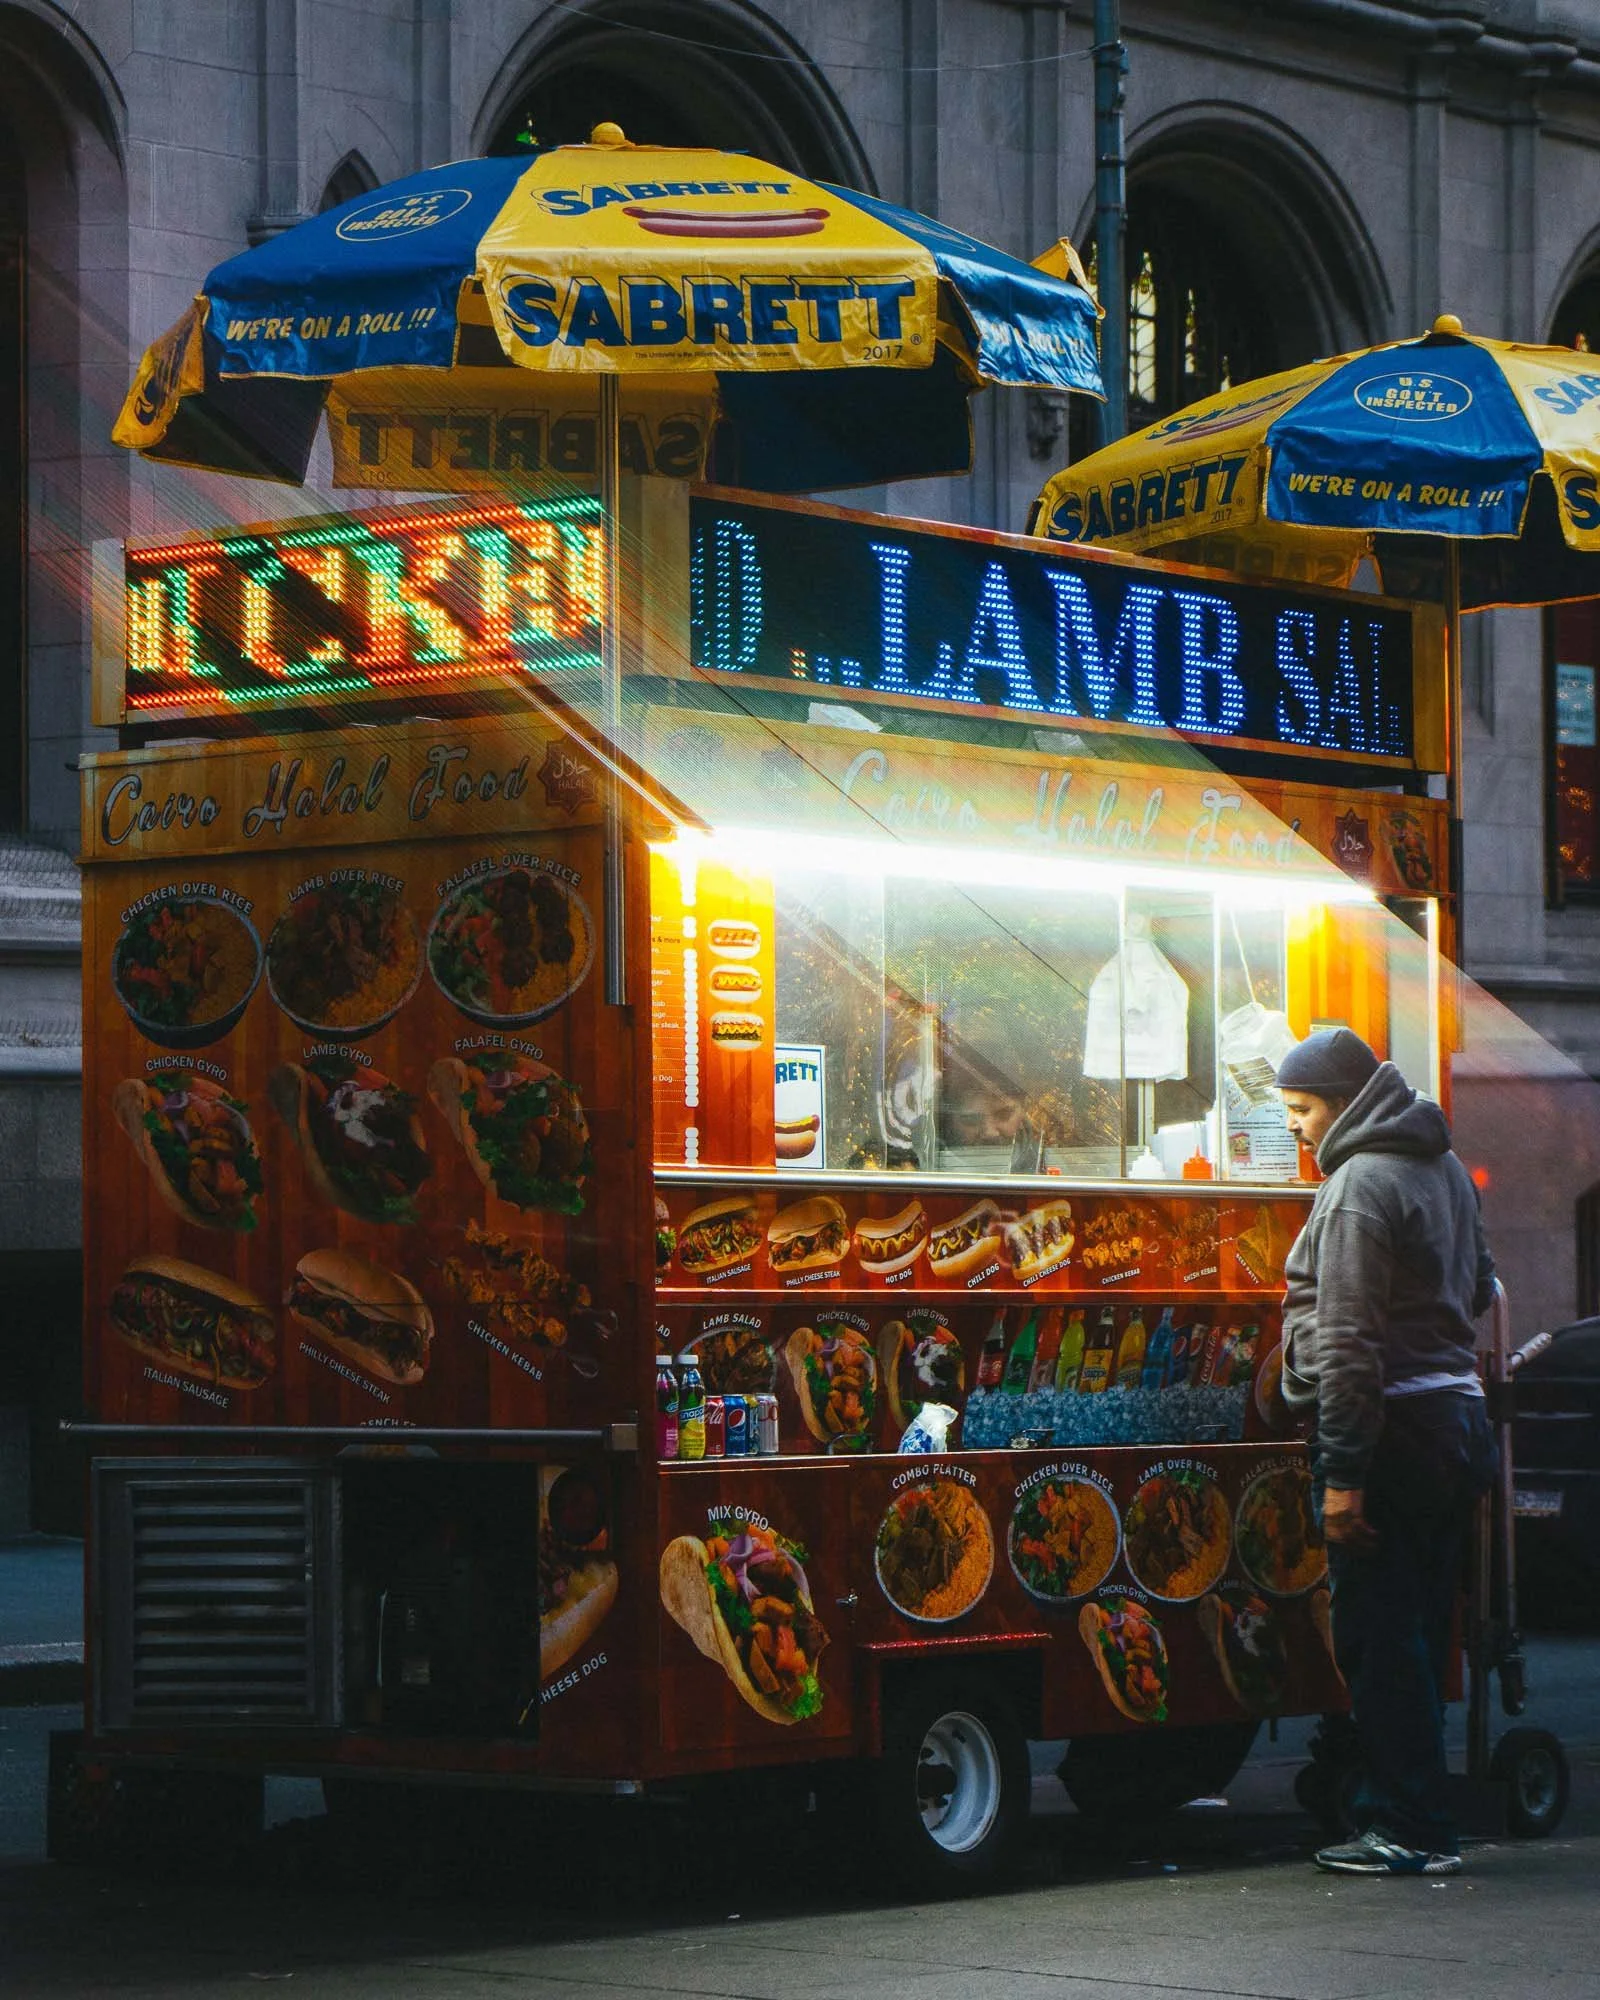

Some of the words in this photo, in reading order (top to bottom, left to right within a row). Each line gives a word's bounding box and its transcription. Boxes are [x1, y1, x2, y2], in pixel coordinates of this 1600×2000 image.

[532, 179, 797, 216] SABRETT
[344, 215, 440, 231] INSPECTED
[500, 274, 915, 348] SABRETT
[225, 317, 294, 341] WE'RE
[300, 315, 333, 339] ON
[336, 316, 353, 337] A
[355, 313, 403, 336] ROLL
[864, 345, 904, 360] 2017
[1366, 397, 1457, 413] INSPECTED
[1048, 449, 1249, 542] SABRETT
[1288, 473, 1356, 497] WE'RE
[1361, 480, 1393, 501] ON
[1397, 484, 1412, 502] A
[1418, 485, 1471, 507] ROLL
[101, 773, 221, 846] Cairo
[243, 752, 390, 838] Halal
[408, 744, 531, 821] Food
[288, 874, 326, 902] LAMB
[329, 869, 366, 885] OVER
[370, 871, 404, 893] RICE
[436, 857, 497, 897] FALAFEL
[501, 854, 541, 869] OVER
[544, 859, 582, 887] RICE
[120, 883, 177, 924] CHICKEN
[183, 882, 216, 896] OVER
[222, 888, 254, 914] RICE
[303, 1043, 337, 1059] LAMB
[339, 1046, 373, 1067] GYRO
[454, 1035, 507, 1053] FALAFEL
[510, 1038, 544, 1060] GYRO
[145, 1055, 194, 1072] CHICKEN
[196, 1060, 228, 1081] GYRO
[706, 1272, 727, 1285] ITALIAN
[727, 1263, 752, 1277] SAUSAGE
[804, 1273, 825, 1284] CHEESE
[825, 1270, 841, 1280] STEAK
[885, 1275, 899, 1285] HOT
[899, 1268, 913, 1280] DOG
[967, 1270, 985, 1288] CHILI
[984, 1262, 1000, 1278] DOG
[1022, 1273, 1039, 1287] CHILI
[1059, 1257, 1071, 1270] DOG
[703, 1314, 730, 1330] LAMB
[731, 1312, 762, 1329] SALAD
[816, 1311, 851, 1322] CHICKEN
[850, 1313, 871, 1332] GYRO
[906, 1308, 929, 1319] LAMB
[928, 1308, 949, 1326] GYRO
[467, 1319, 511, 1356] CHICKEN
[511, 1351, 544, 1381] KEBAB
[299, 1341, 329, 1364] PHILLY
[328, 1358, 363, 1385] CHEESE
[362, 1379, 391, 1404] STEAK
[143, 1367, 181, 1388] ITALIAN
[182, 1380, 230, 1408] SAUSAGE
[892, 1464, 930, 1490] COMBO
[932, 1463, 978, 1487] PLATTER
[1014, 1463, 1059, 1499] CHICKEN
[1061, 1462, 1088, 1475] OVER
[1090, 1470, 1114, 1494] RICE
[1138, 1463, 1165, 1484] LAMB
[1167, 1459, 1193, 1471] OVER
[1196, 1462, 1219, 1482] RICE
[707, 1504, 732, 1522] MIX
[734, 1505, 769, 1532] GYRO
[1098, 1583, 1128, 1598] CHICKEN
[1127, 1586, 1149, 1605] GYRO
[540, 1670, 581, 1705] HEESE
[581, 1651, 608, 1677] DOG
